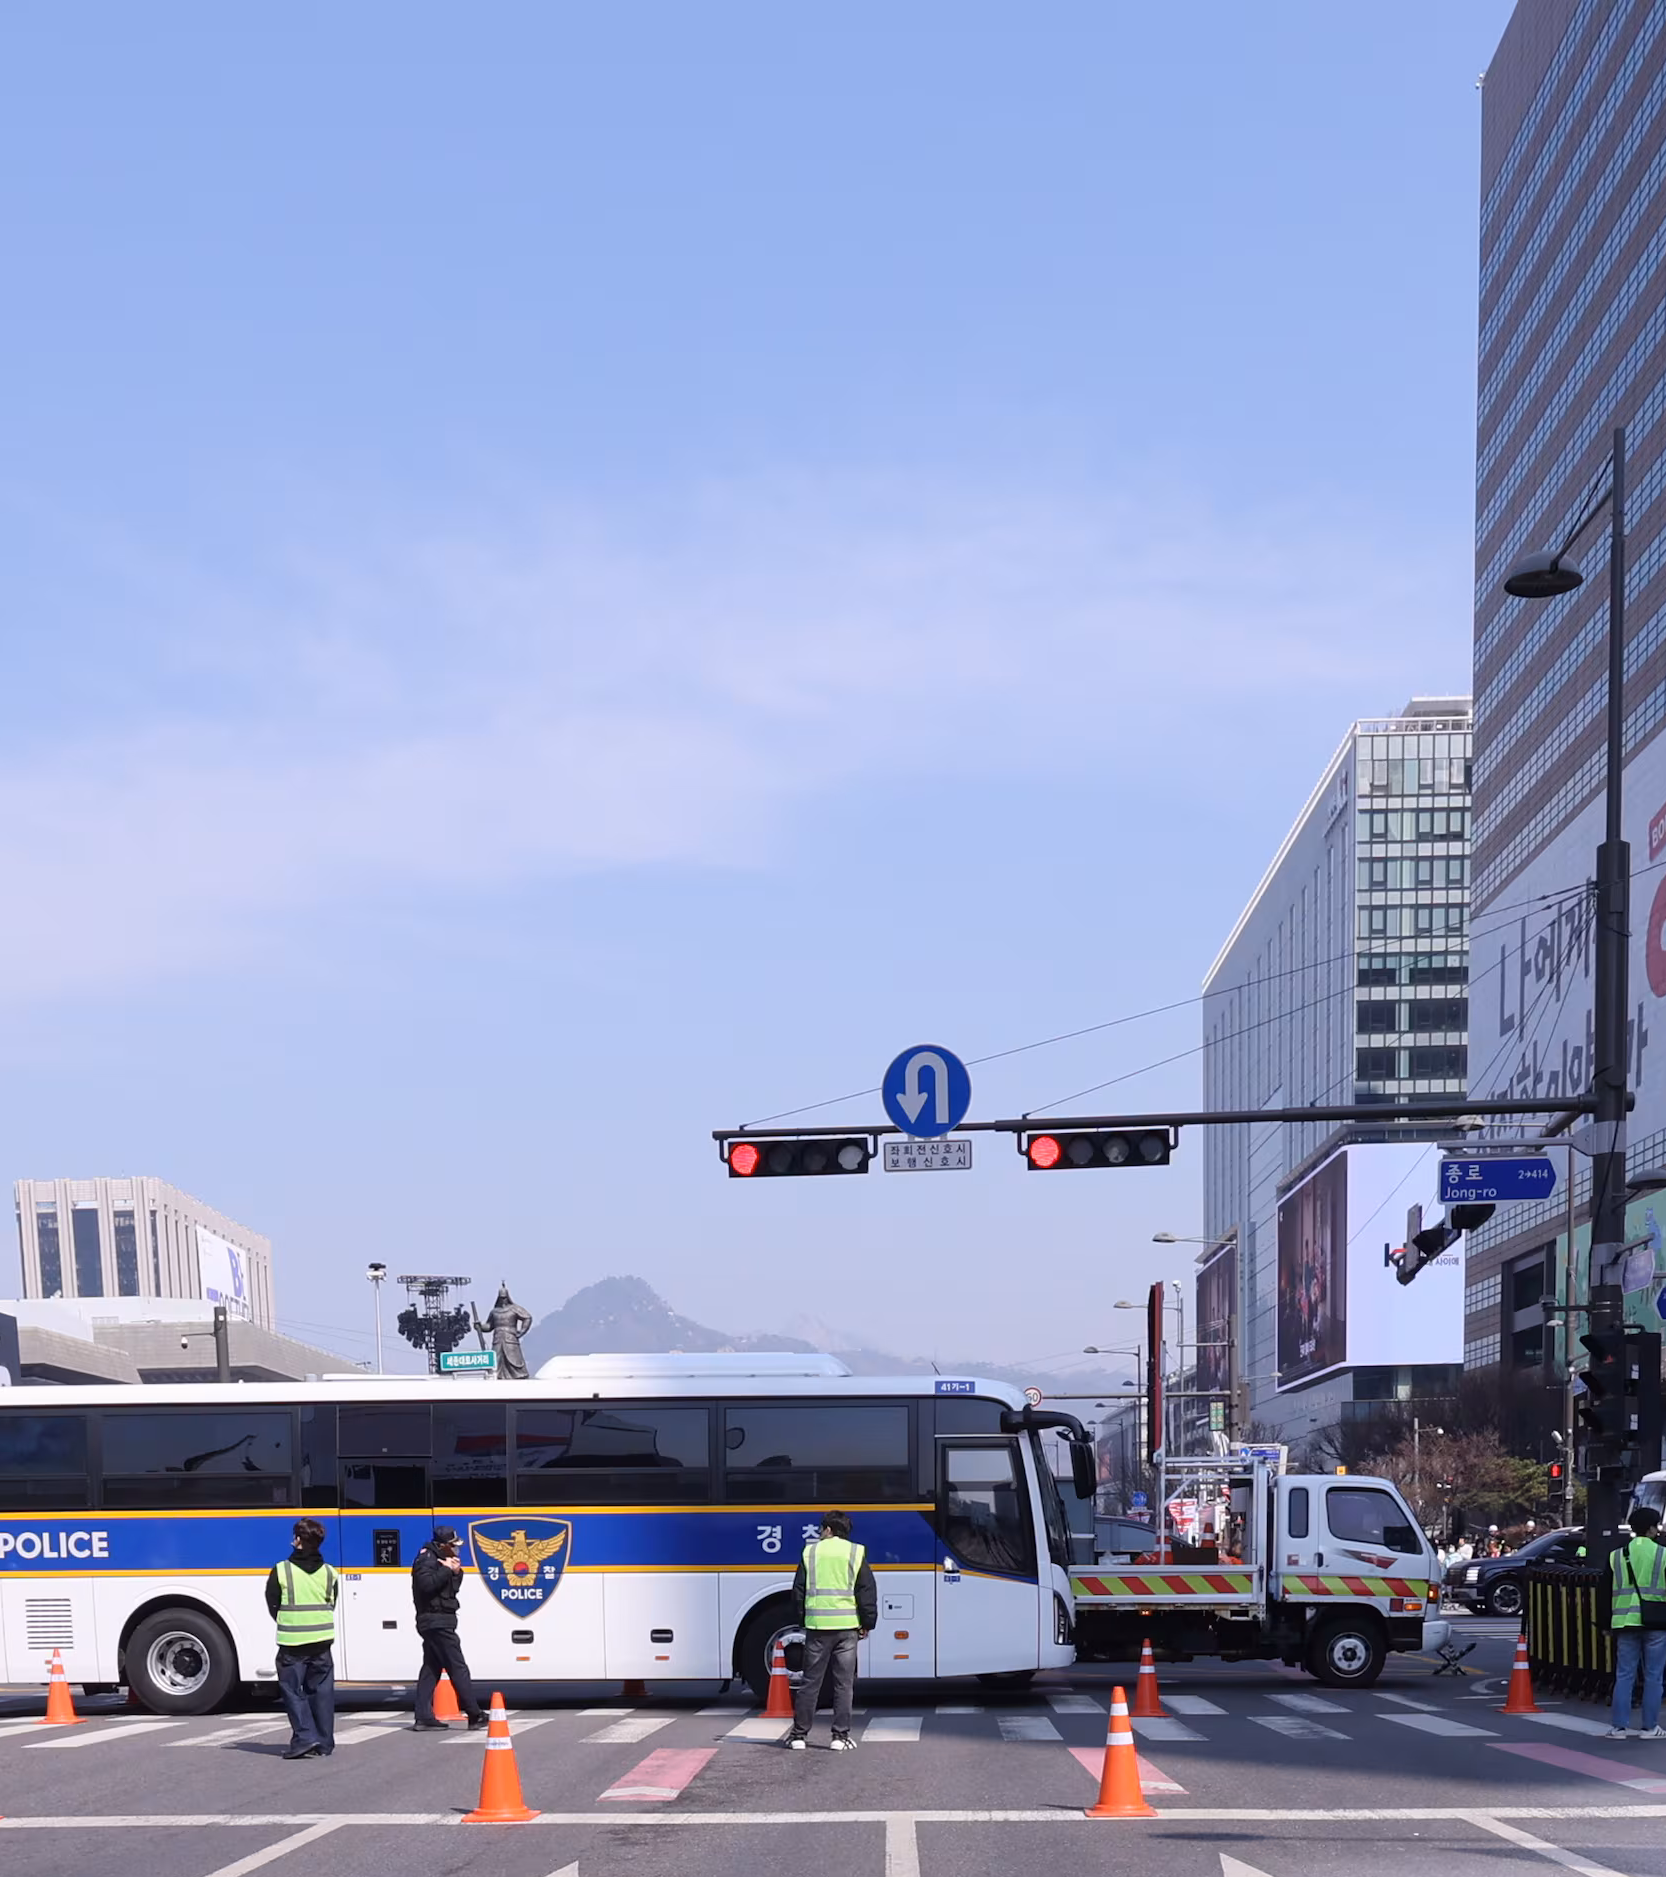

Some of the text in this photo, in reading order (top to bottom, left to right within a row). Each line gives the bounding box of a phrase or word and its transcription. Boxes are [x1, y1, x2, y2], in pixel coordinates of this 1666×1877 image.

[1499, 875, 1597, 1043] 나에게
[1445, 1187, 1497, 1200] Jong-ro
[941, 1382, 970, 1392] 41기-1
[501, 1588, 543, 1600] POLICE
